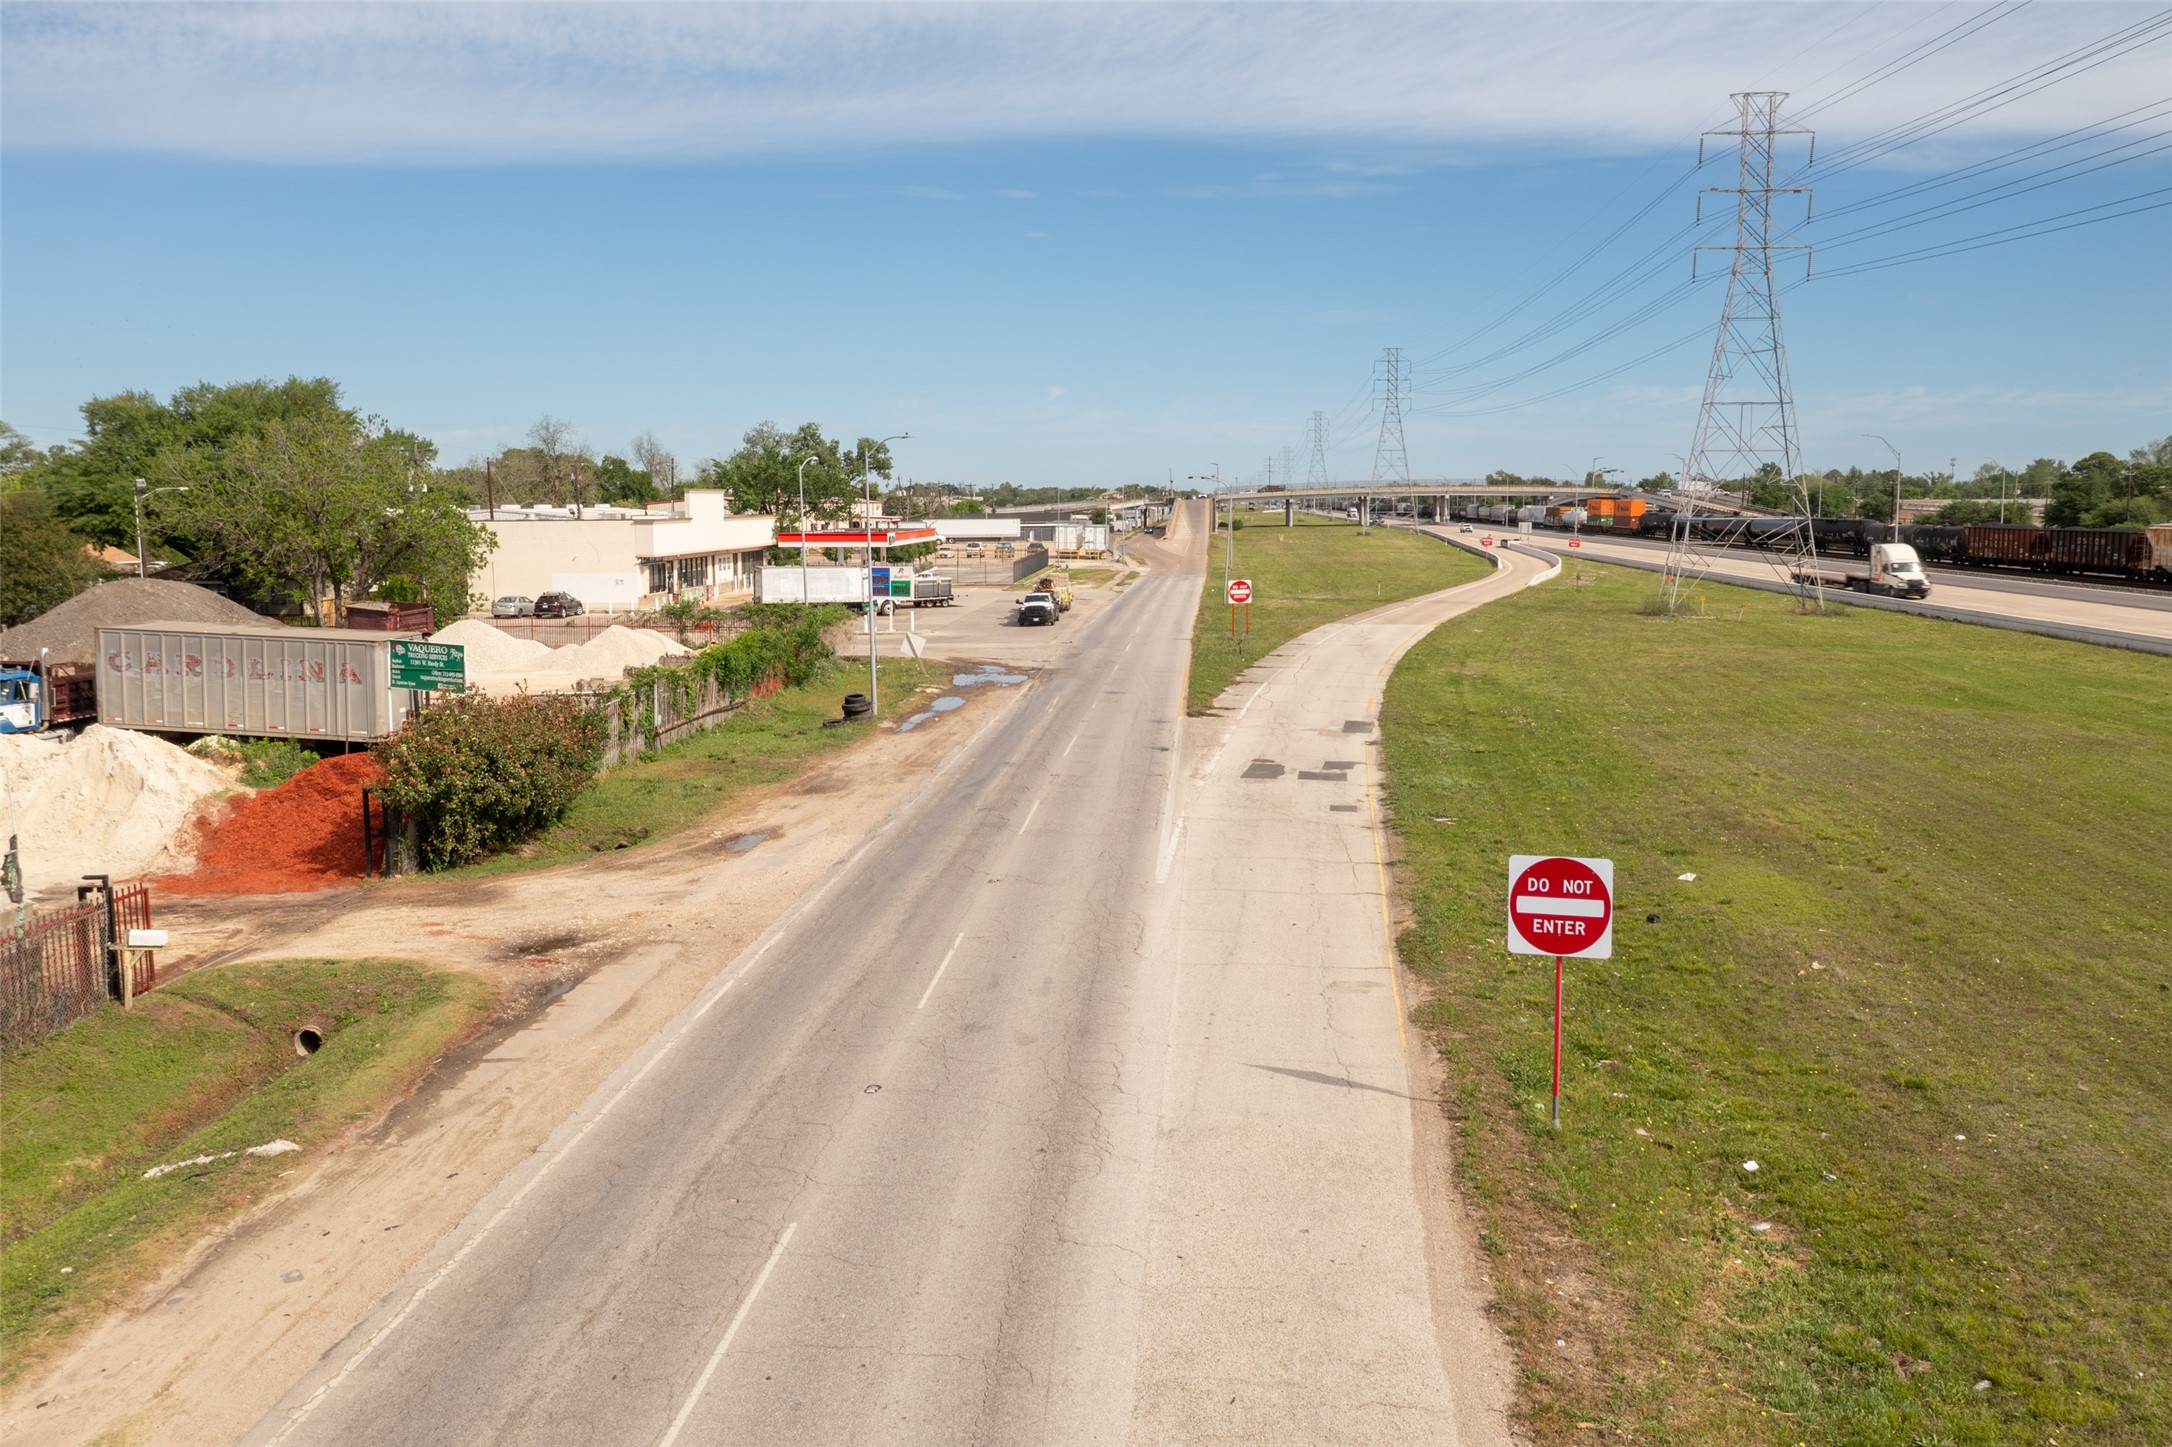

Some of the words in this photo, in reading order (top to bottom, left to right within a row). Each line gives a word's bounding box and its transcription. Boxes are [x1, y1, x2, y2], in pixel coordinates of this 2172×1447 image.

[408, 643, 448, 654] VAQUERO
[108, 650, 363, 685] CAROLINA
[1527, 877, 1550, 893] DO
[1563, 879, 1593, 895] NOT
[1533, 918, 1586, 936] ENTER
